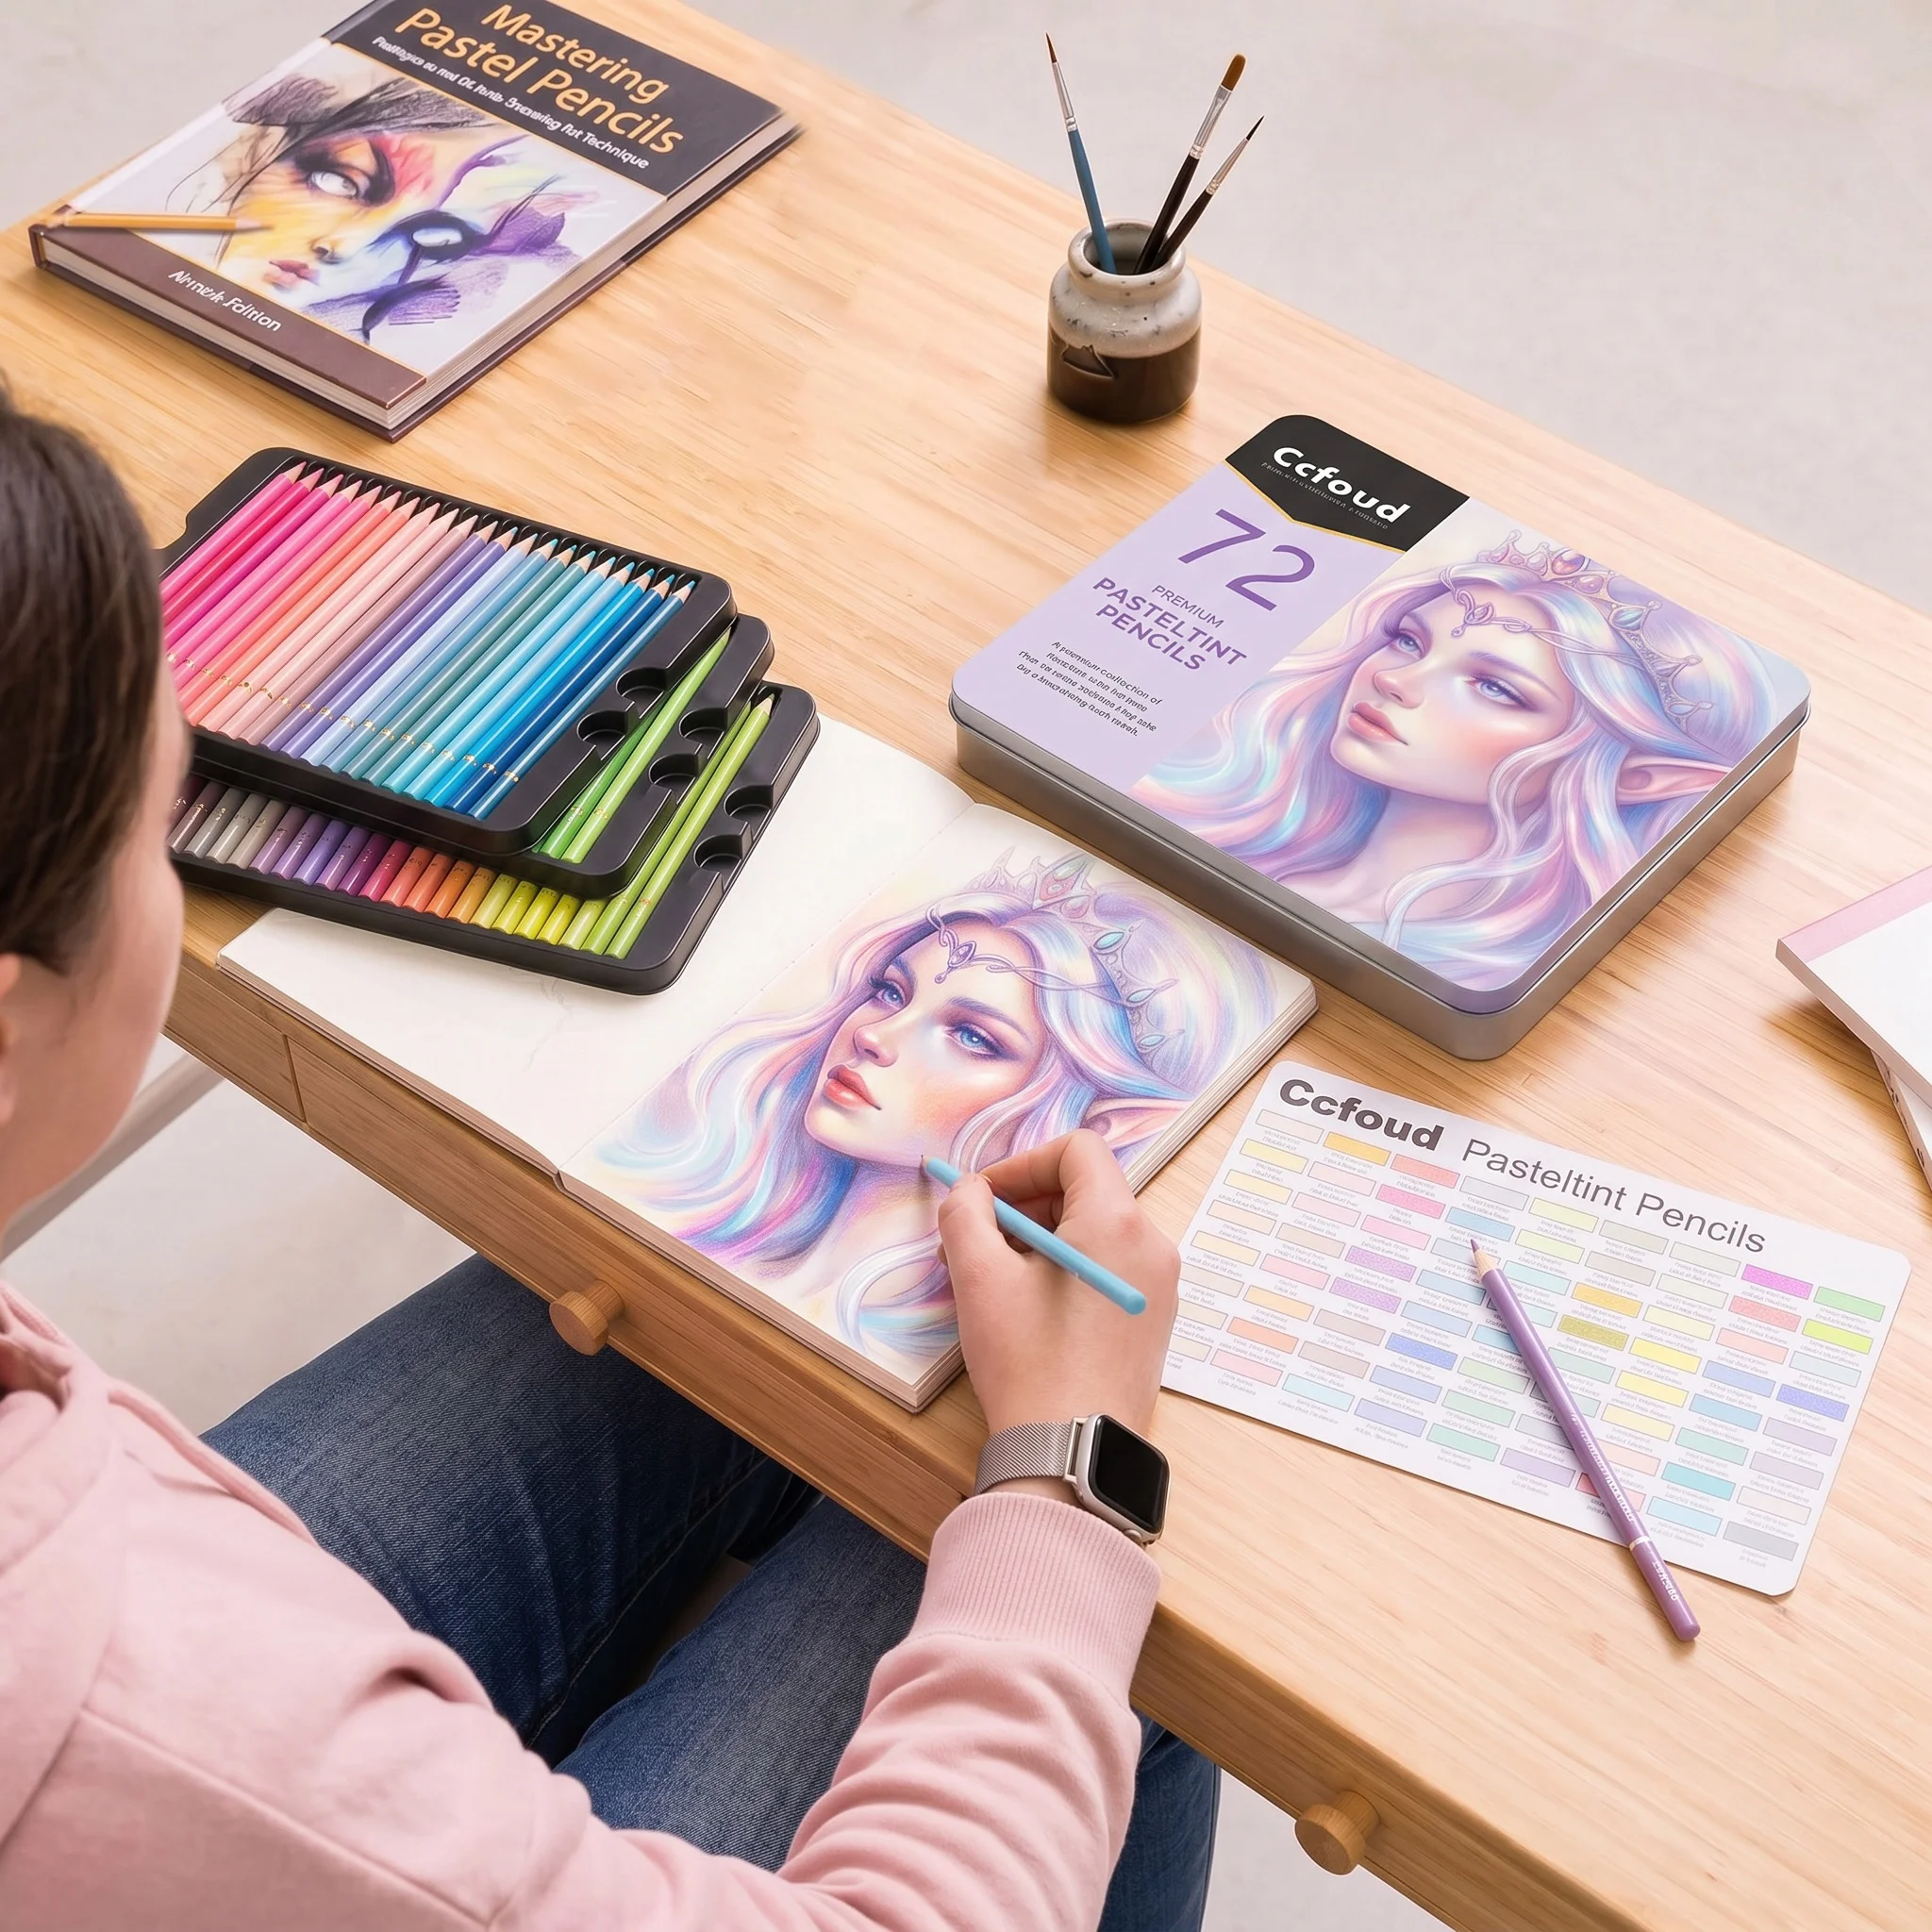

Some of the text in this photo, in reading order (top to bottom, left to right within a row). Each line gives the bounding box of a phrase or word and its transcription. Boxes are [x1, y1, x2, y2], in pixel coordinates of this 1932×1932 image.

[394, 8, 539, 84] Pastel
[526, 68, 684, 154] Pencils
[481, 4, 669, 104] Mastering
[1273, 446, 1410, 523] Ccfoud
[1152, 585, 1224, 628] PREMIUM
[1177, 508, 1315, 611] 72
[1092, 577, 1247, 666] PASTELTINT
[1095, 604, 1206, 671] PENCILS
[1279, 1078, 1767, 1254] Ccfoud Pasteltint Pencils
